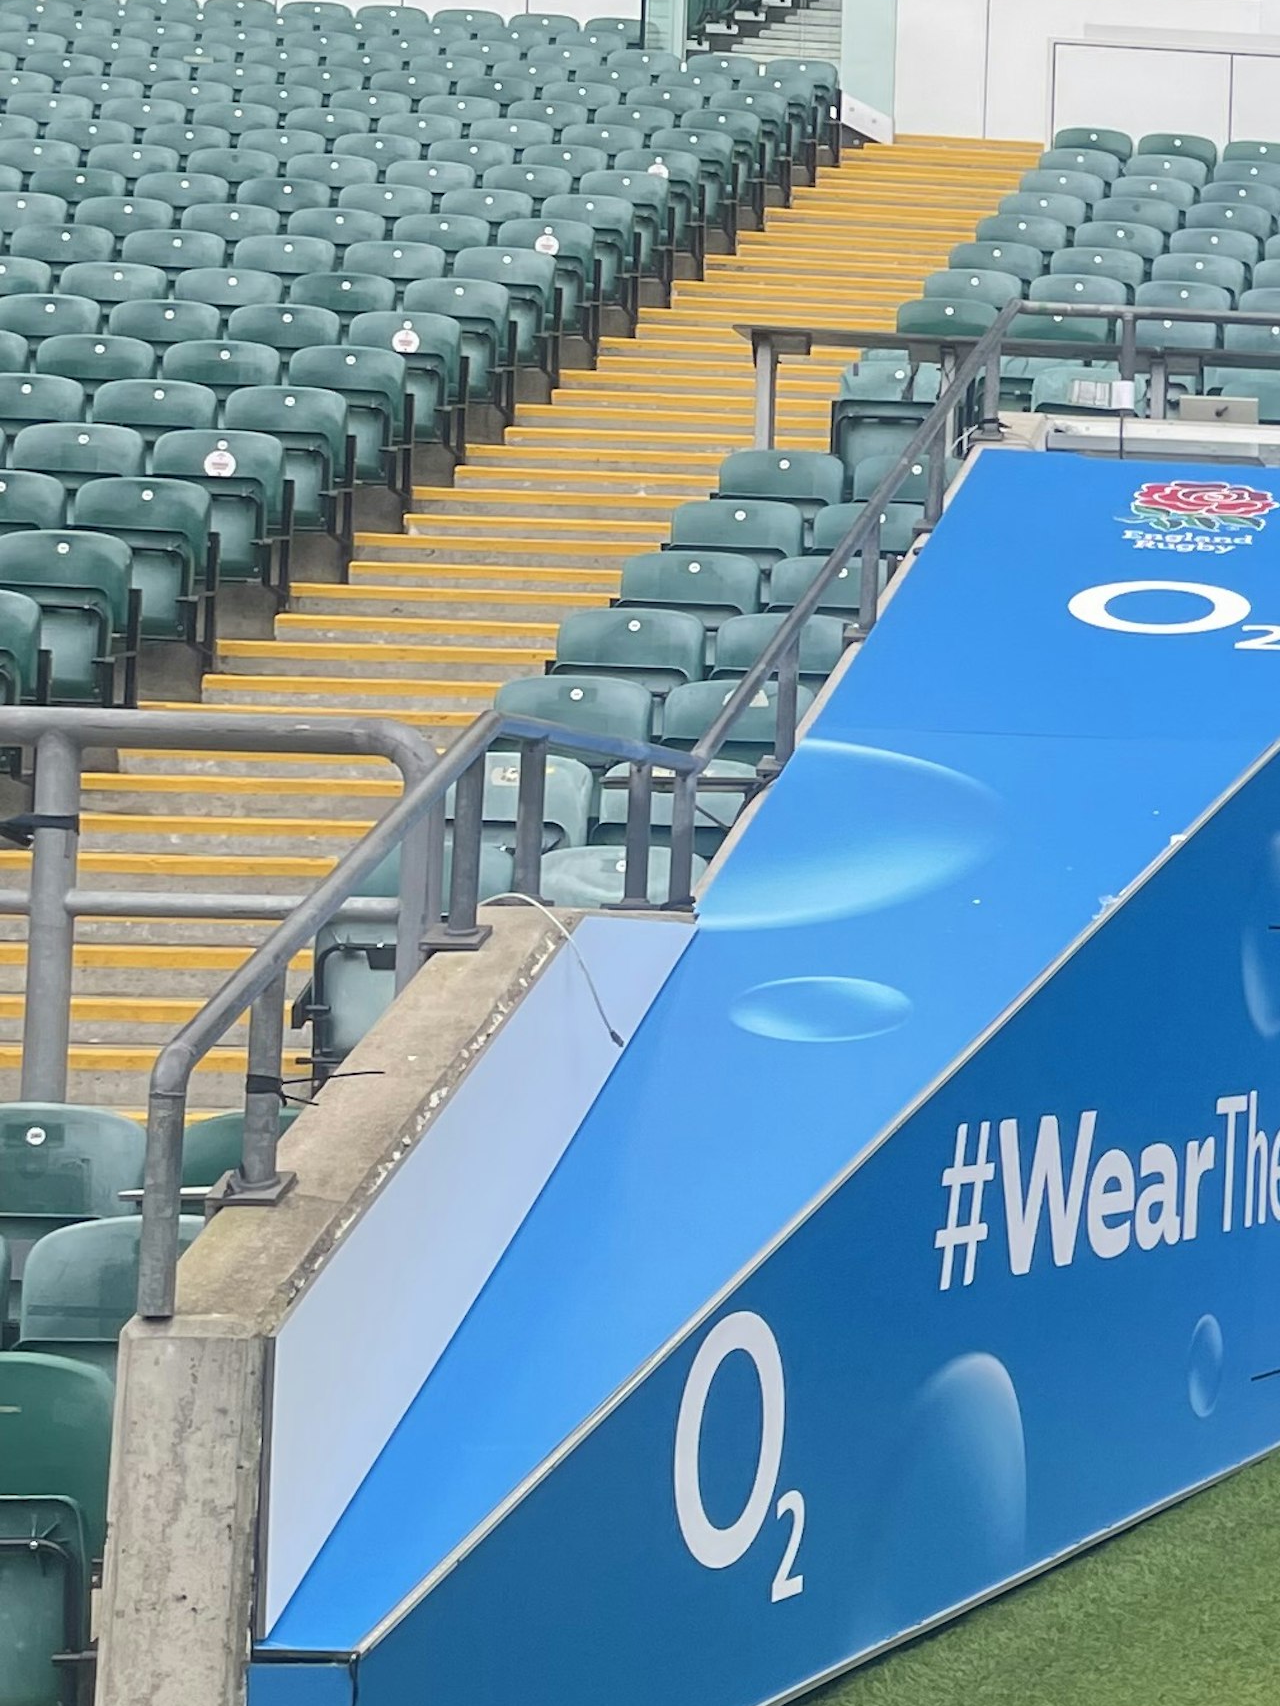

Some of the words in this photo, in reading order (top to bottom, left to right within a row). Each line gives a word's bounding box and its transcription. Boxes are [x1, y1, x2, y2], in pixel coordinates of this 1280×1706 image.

[1121, 529, 1253, 548] England
[1132, 539, 1237, 555] Rugby
[674, 1311, 807, 1603] O2
